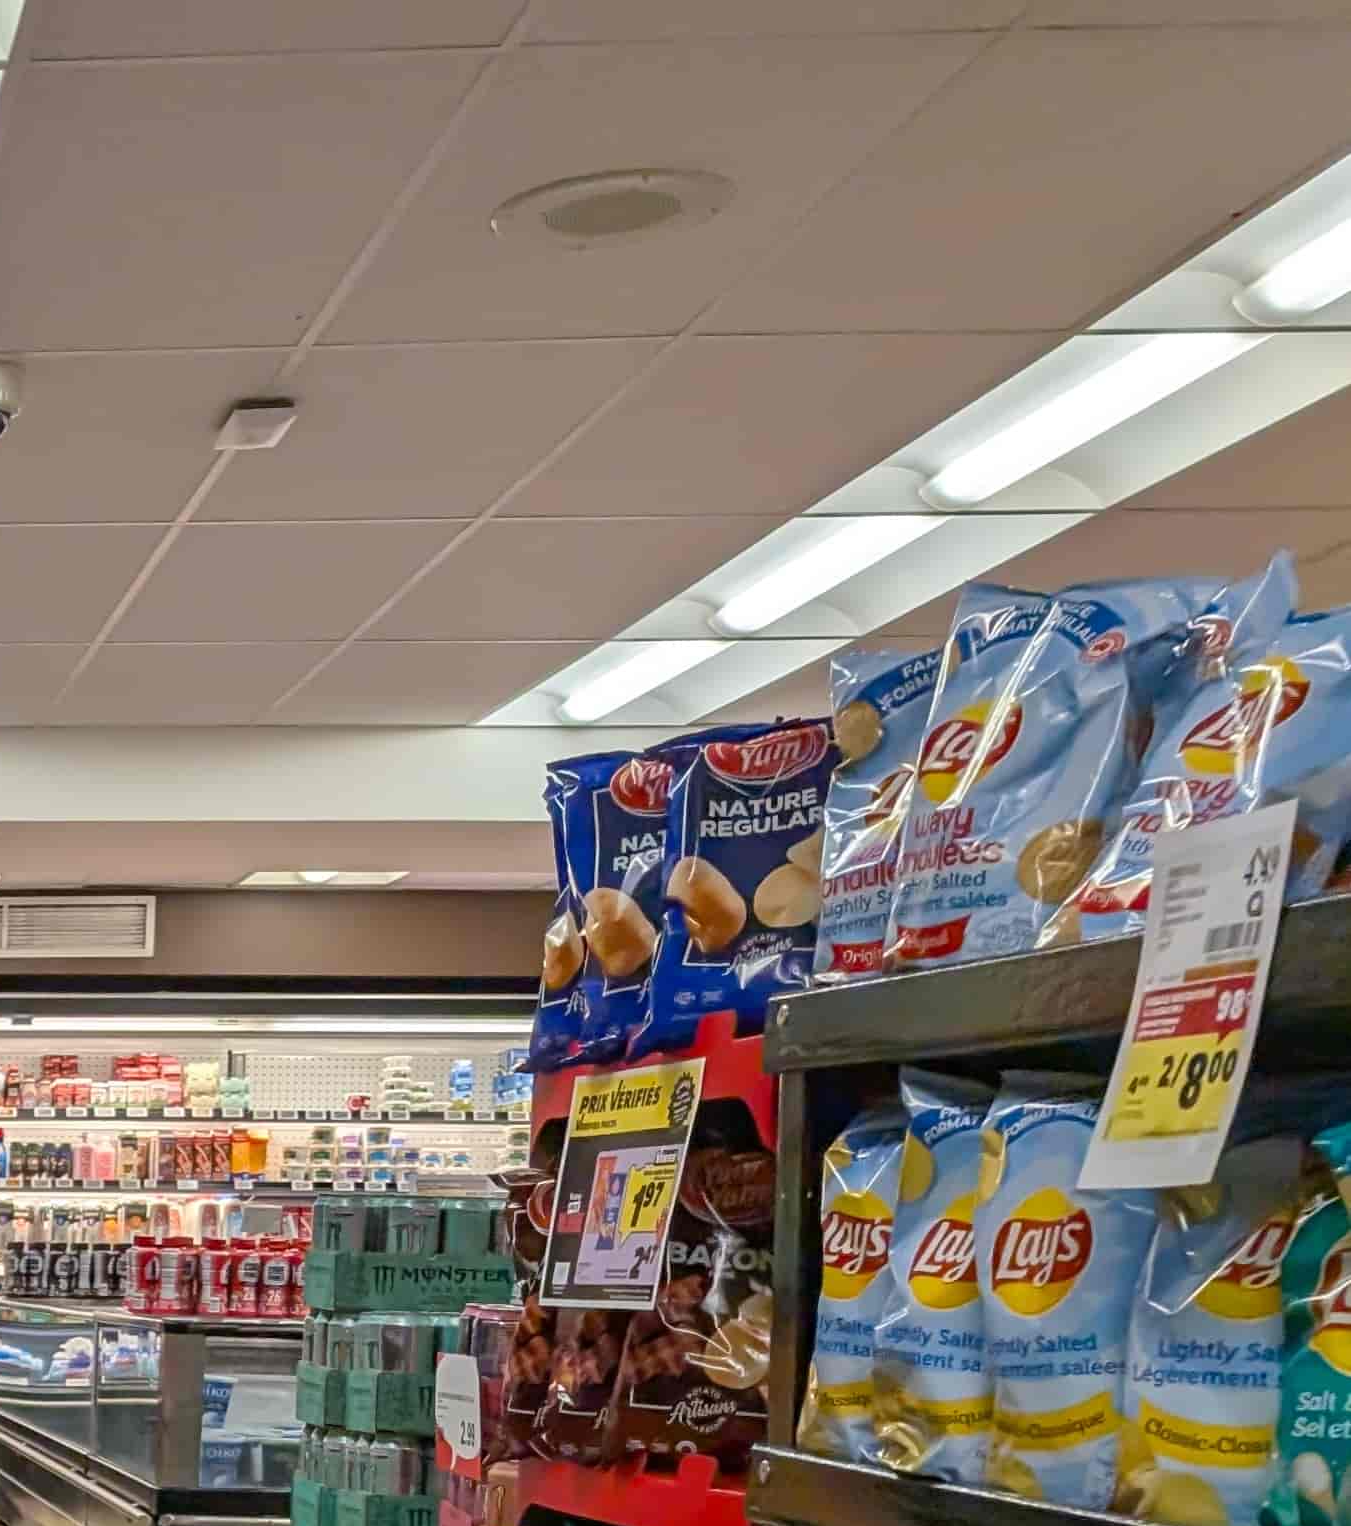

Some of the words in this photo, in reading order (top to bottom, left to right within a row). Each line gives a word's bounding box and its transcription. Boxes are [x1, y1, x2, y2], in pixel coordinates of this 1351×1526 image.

[708, 787, 818, 818] NATURE
[699, 805, 825, 839] REGULAR
[915, 808, 975, 839] wavy
[579, 1093, 608, 1115] PRIX
[913, 1218, 976, 1282] Lay
[996, 1218, 1087, 1282] Lay's
[1158, 1340, 1239, 1364] Lightly
[1295, 1390, 1337, 1412] Salt
[1291, 1416, 1325, 1439] Sel
